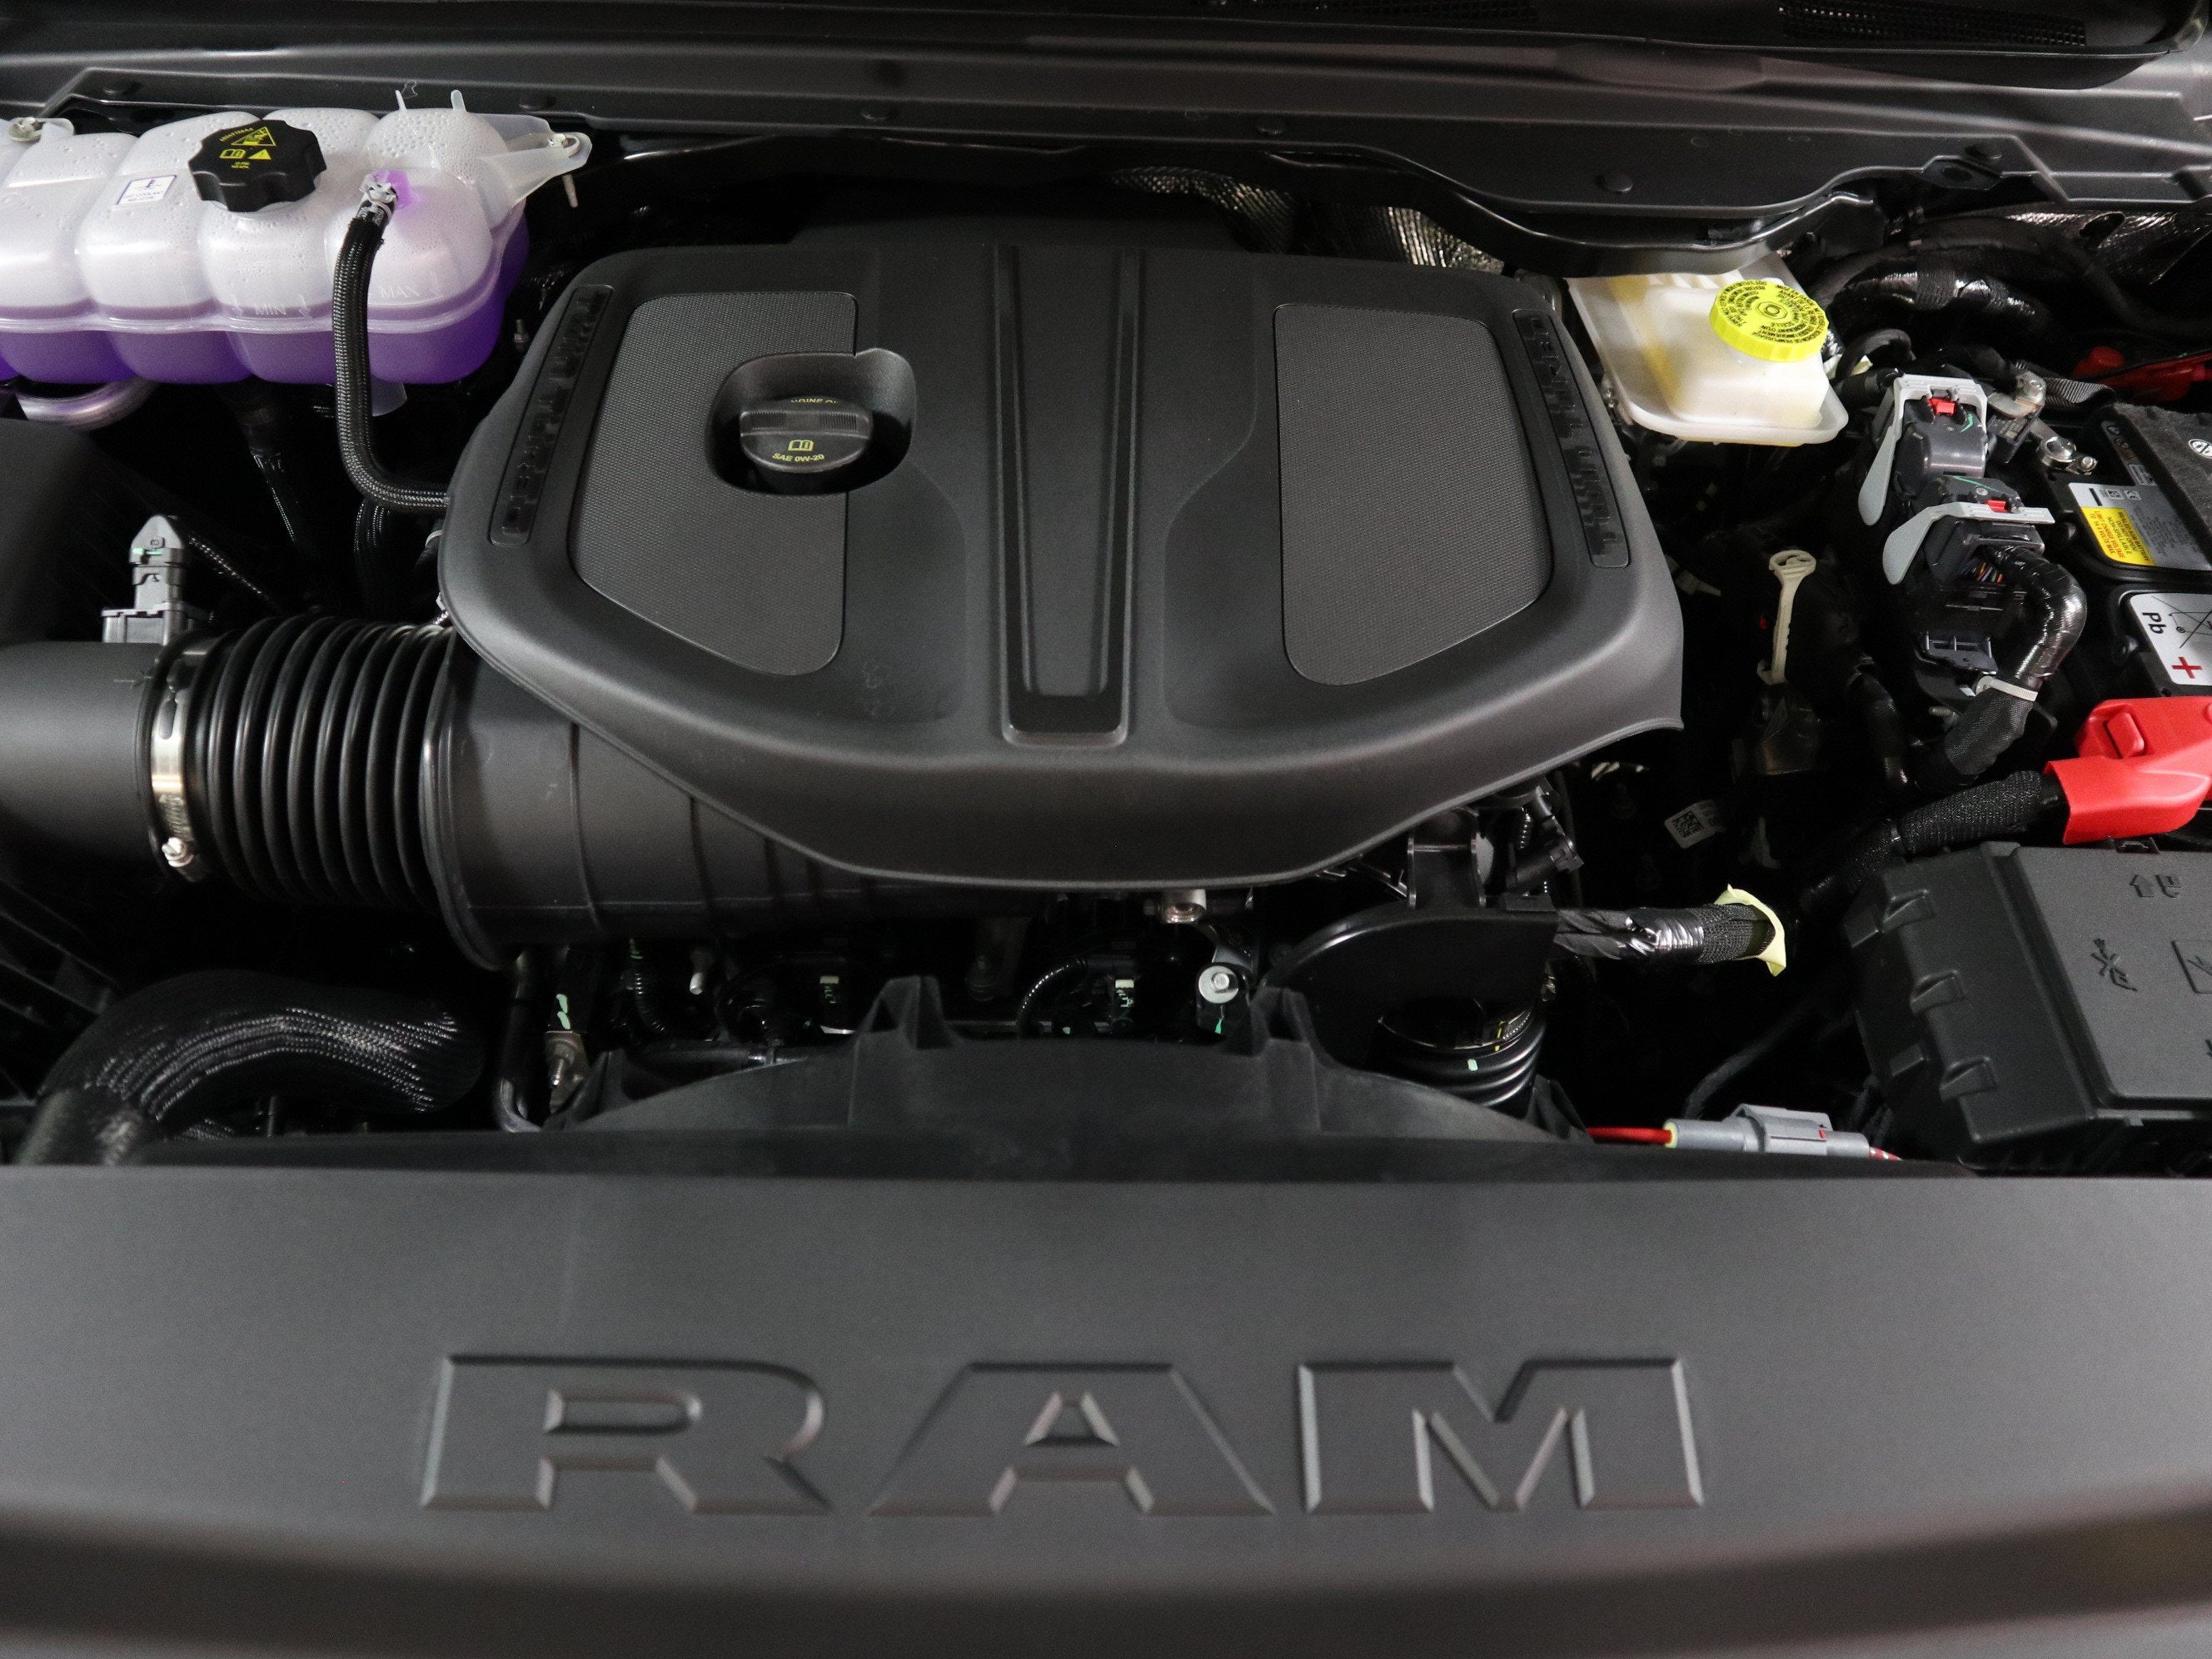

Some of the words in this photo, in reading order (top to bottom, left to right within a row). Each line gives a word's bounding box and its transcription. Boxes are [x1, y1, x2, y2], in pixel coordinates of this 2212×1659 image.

[772, 452, 791, 462] SAE
[794, 454, 825, 462] 0W-20
[2142, 611, 2167, 635] Pb
[419, 1354, 1706, 1517] RAM
